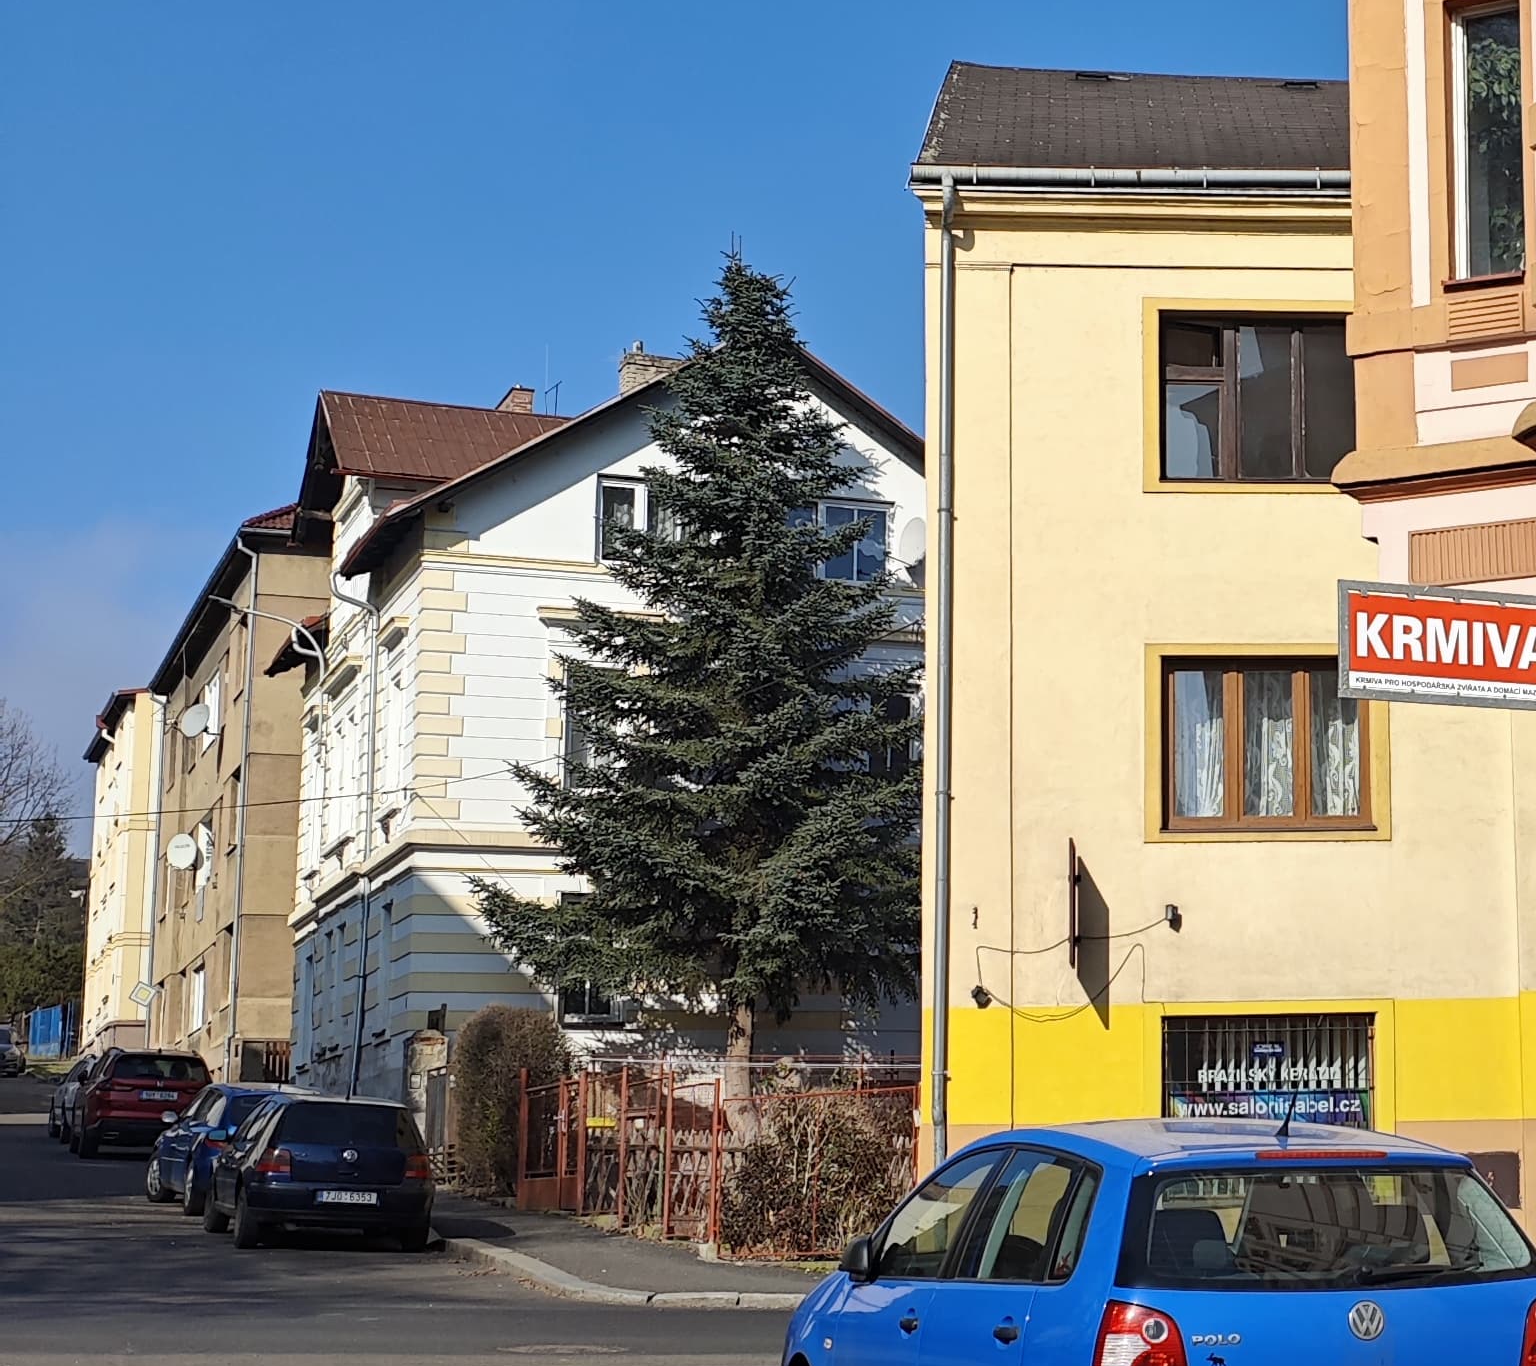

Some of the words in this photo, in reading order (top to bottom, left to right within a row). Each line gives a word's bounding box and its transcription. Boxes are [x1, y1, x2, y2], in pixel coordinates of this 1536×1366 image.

[1355, 676, 1383, 685] KRMIVA
[1384, 678, 1400, 687] PRO
[349, 1192, 372, 1202] 6353
[1191, 1332, 1242, 1347] POLO
